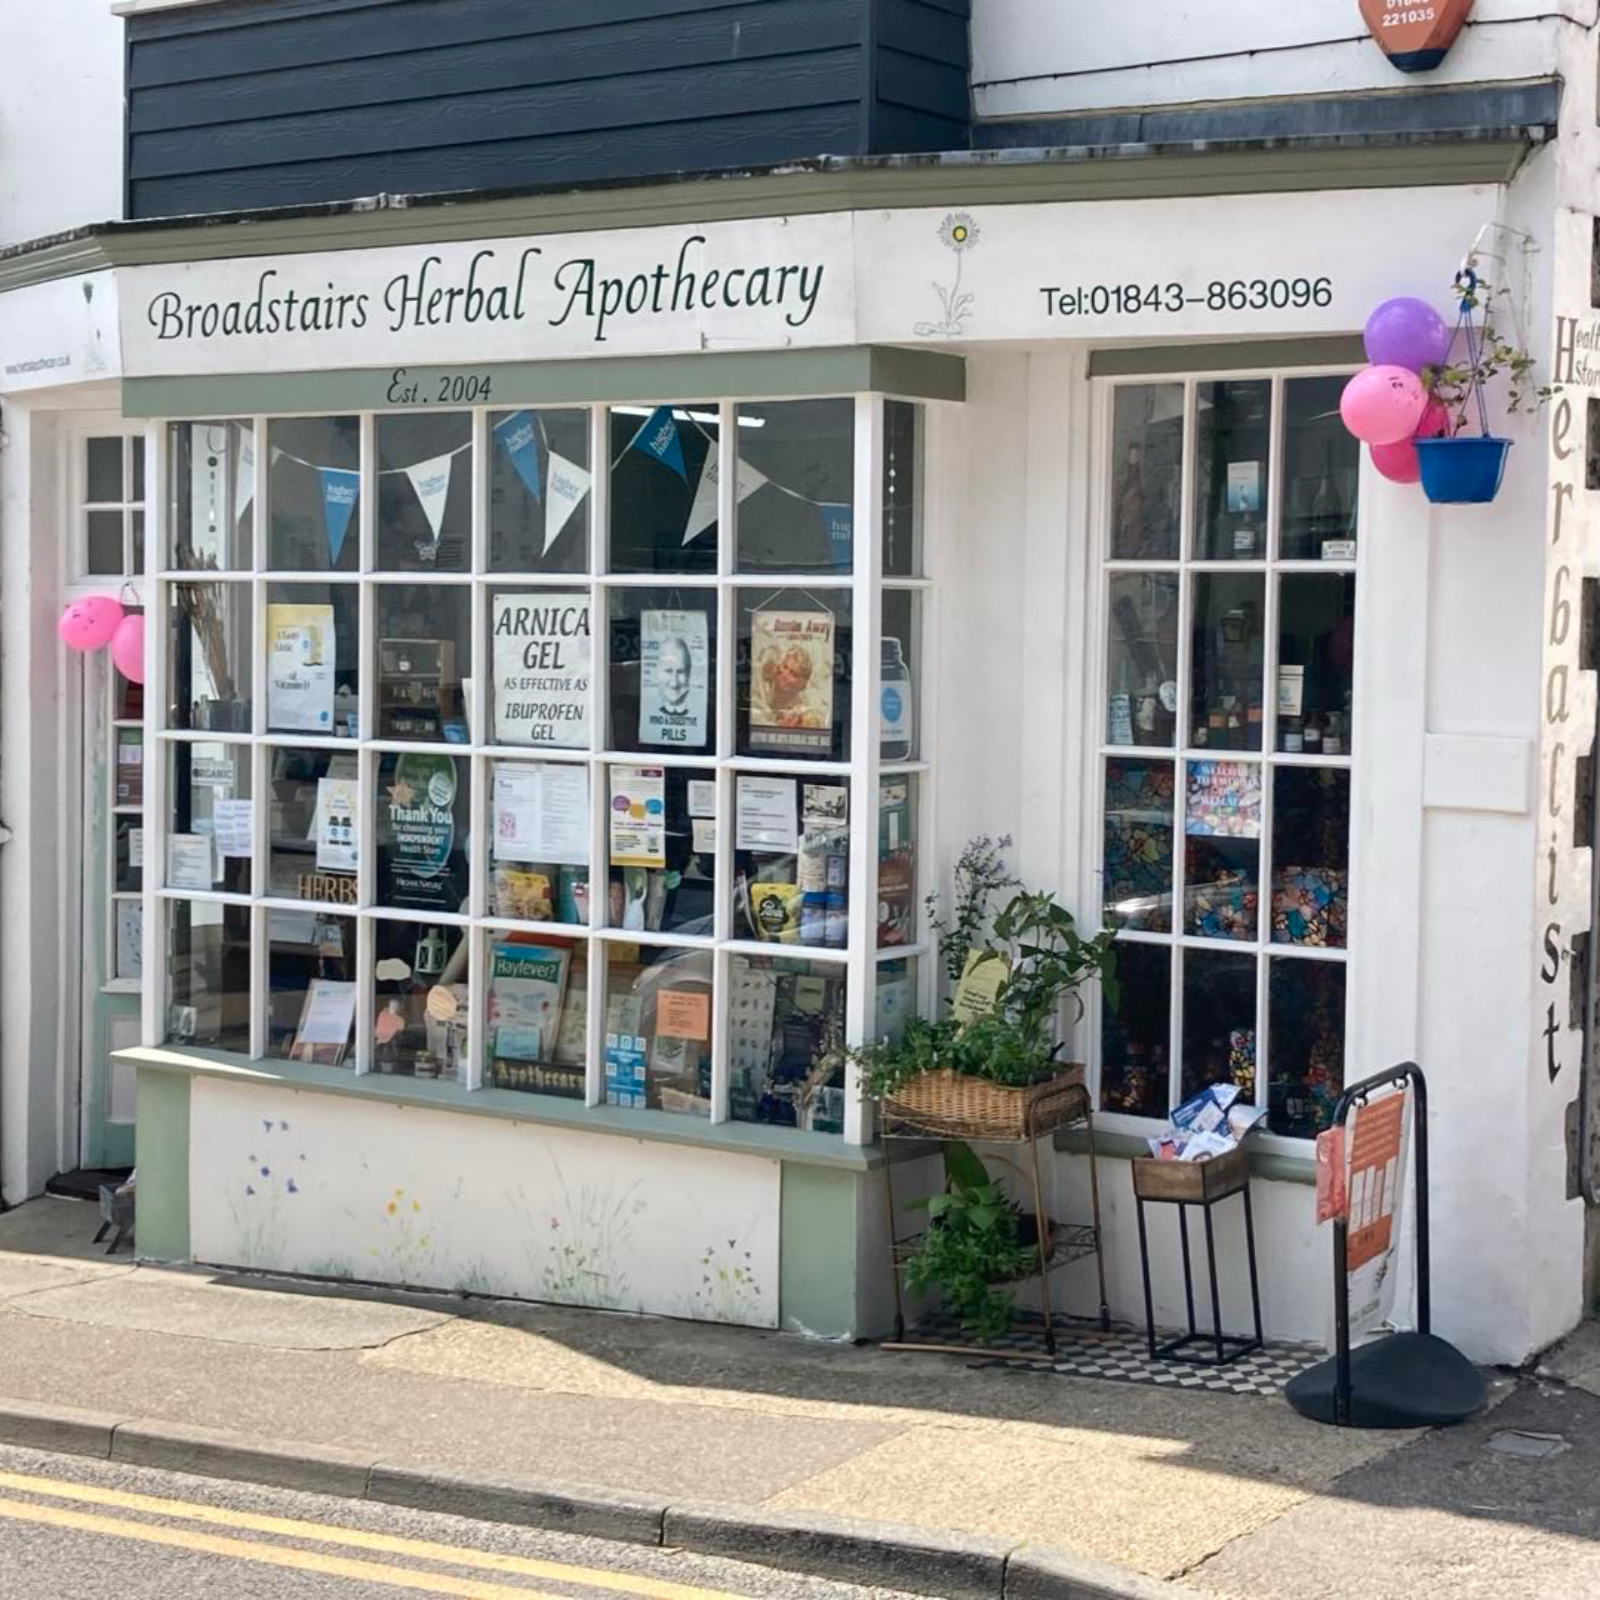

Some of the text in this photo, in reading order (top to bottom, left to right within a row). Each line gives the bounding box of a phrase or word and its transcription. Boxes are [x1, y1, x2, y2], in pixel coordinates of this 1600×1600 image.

[1382, 8, 1435, 26] 221035
[148, 236, 825, 341] Broadstairs Herbal Apothecary
[438, 375, 492, 402] 2004
[495, 607, 590, 636] ARNICA
[523, 641, 565, 669] GEL
[503, 677, 588, 691] AS EFFECTIVE AS
[505, 702, 585, 721] IBUPROFEN
[531, 723, 556, 740] GEL
[661, 728, 687, 741] PILLS
[388, 804, 452, 824] Thank You
[497, 959, 557, 979] Hayfever?
